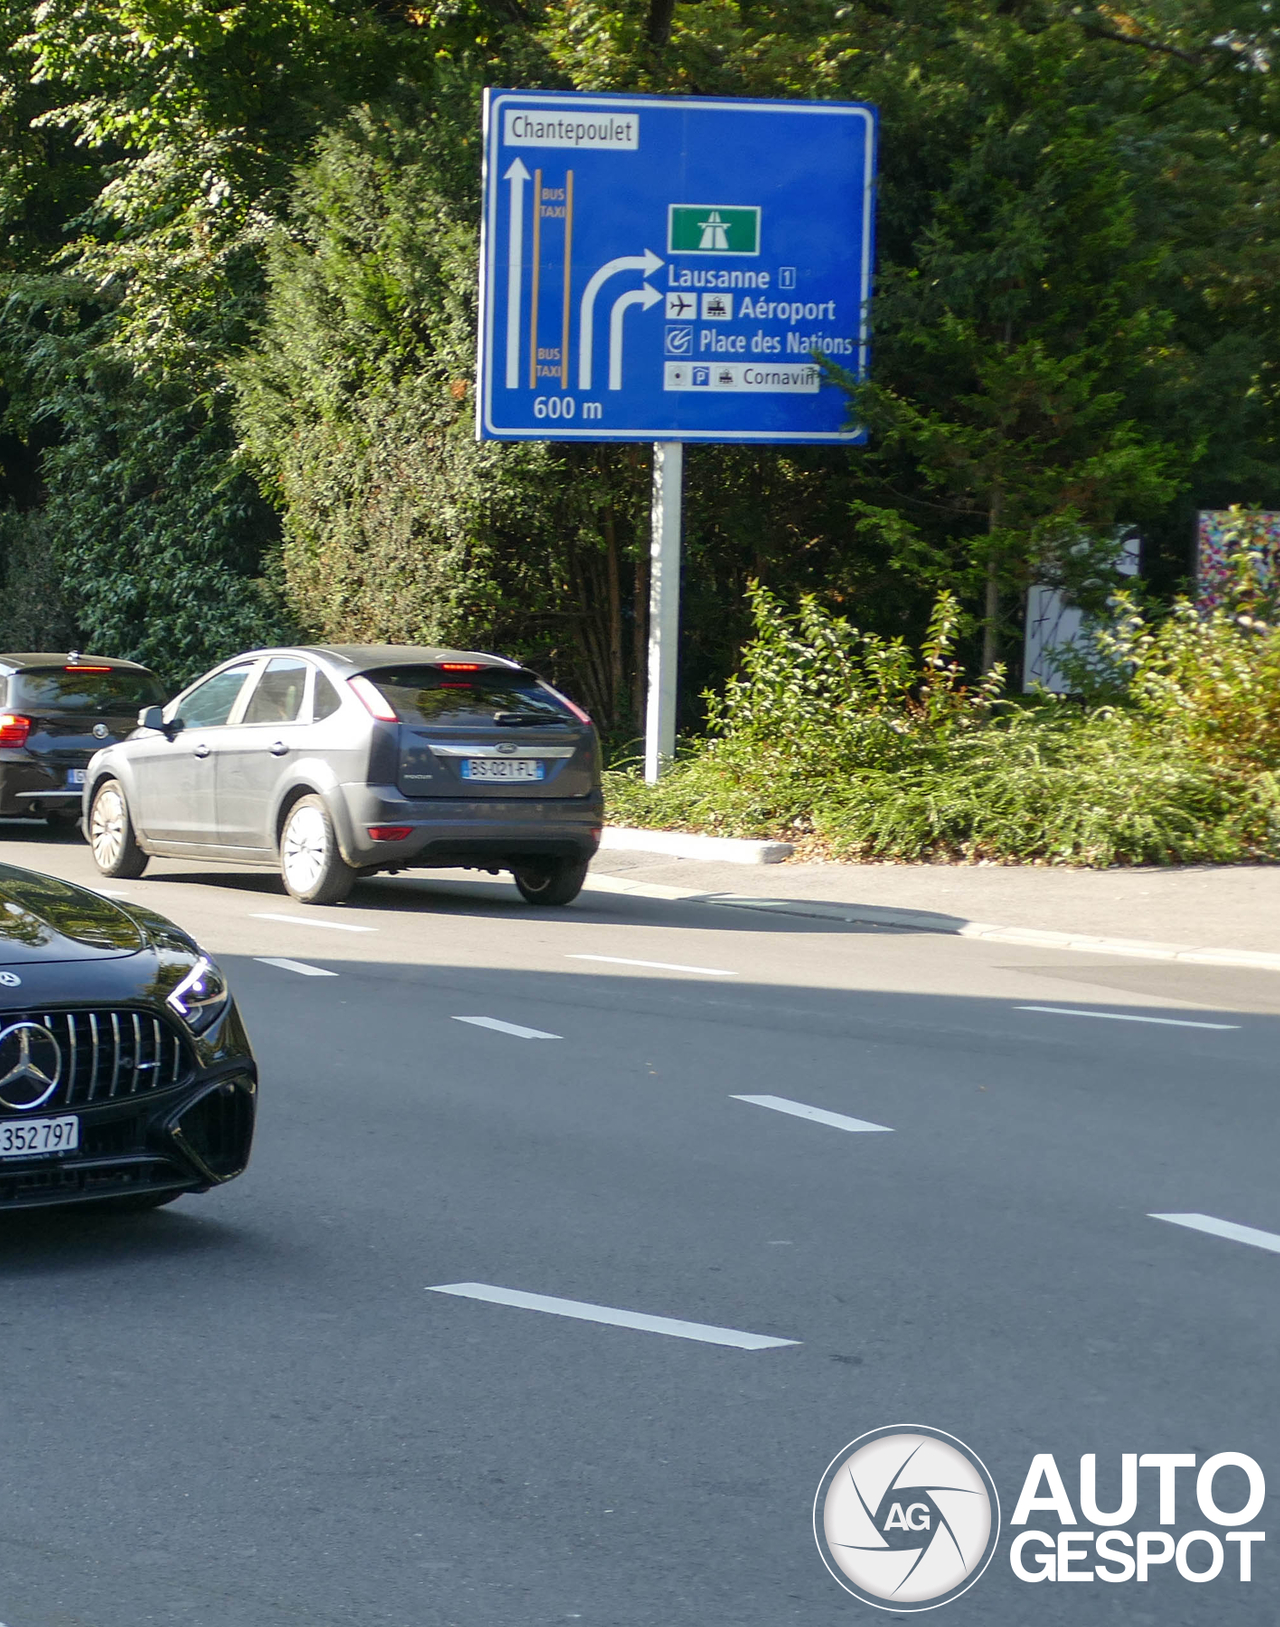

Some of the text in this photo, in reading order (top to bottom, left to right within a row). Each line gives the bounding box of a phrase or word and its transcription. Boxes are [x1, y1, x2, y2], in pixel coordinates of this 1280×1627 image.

[512, 115, 632, 146] Chantepoulet
[541, 187, 565, 201] BUS
[540, 205, 566, 218] TAXI
[668, 264, 791, 289] Lausanne 1
[738, 296, 836, 326] Aéroport
[700, 328, 853, 355] Place des Nations
[537, 347, 561, 360] BUS
[535, 365, 562, 378] TAXI
[743, 368, 815, 386] Cornavin
[533, 396, 602, 419] 600 m
[470, 761, 534, 776] BS-021-FL
